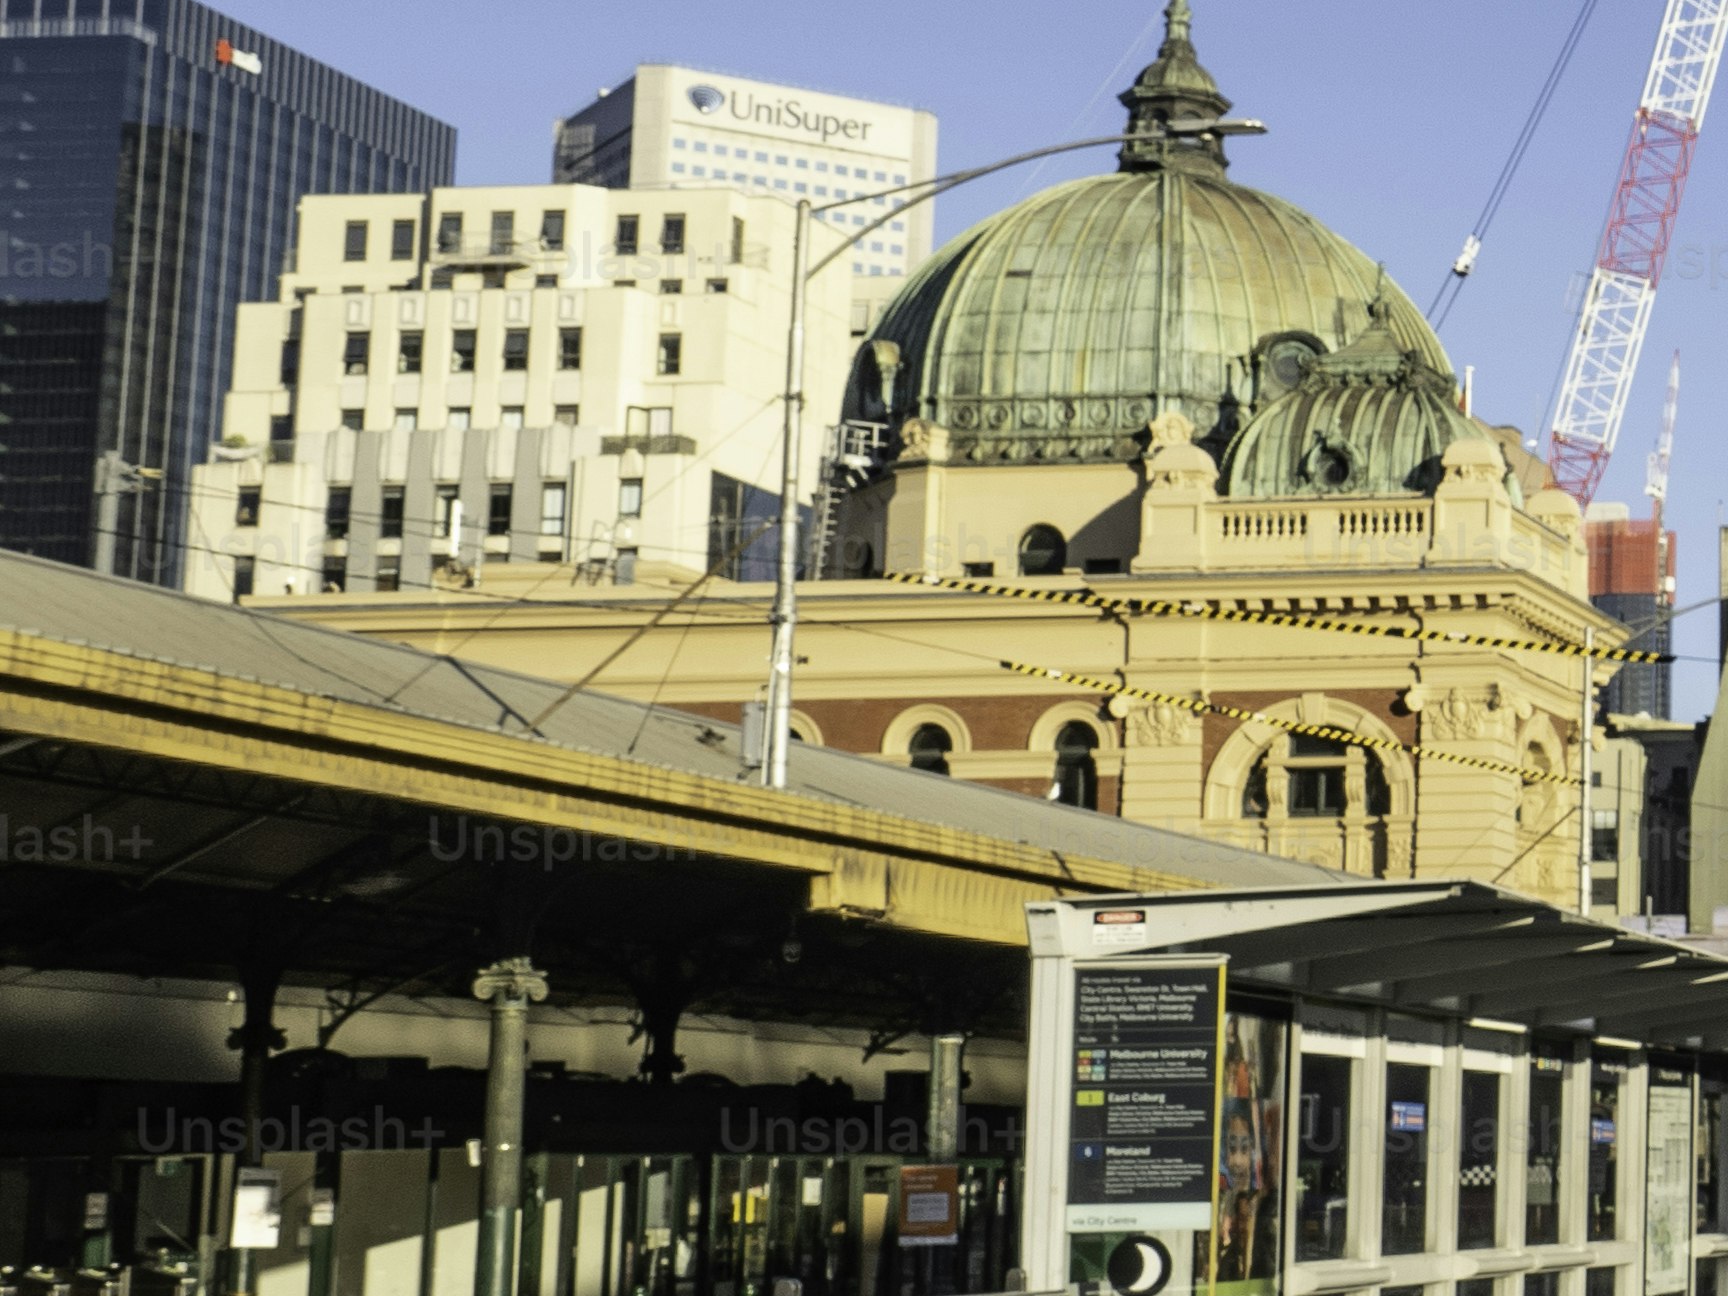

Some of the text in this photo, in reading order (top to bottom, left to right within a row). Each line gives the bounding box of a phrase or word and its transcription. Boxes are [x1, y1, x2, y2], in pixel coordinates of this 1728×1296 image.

[728, 92, 874, 146] UniSuper
[1109, 1048, 1208, 1061] Melbourne University
[1107, 1092, 1130, 1103] East
[1131, 1092, 1166, 1105] Coburg
[1105, 1146, 1151, 1156] Moreland
[1087, 1217, 1105, 1227] City
[1107, 1216, 1137, 1225] Centre
